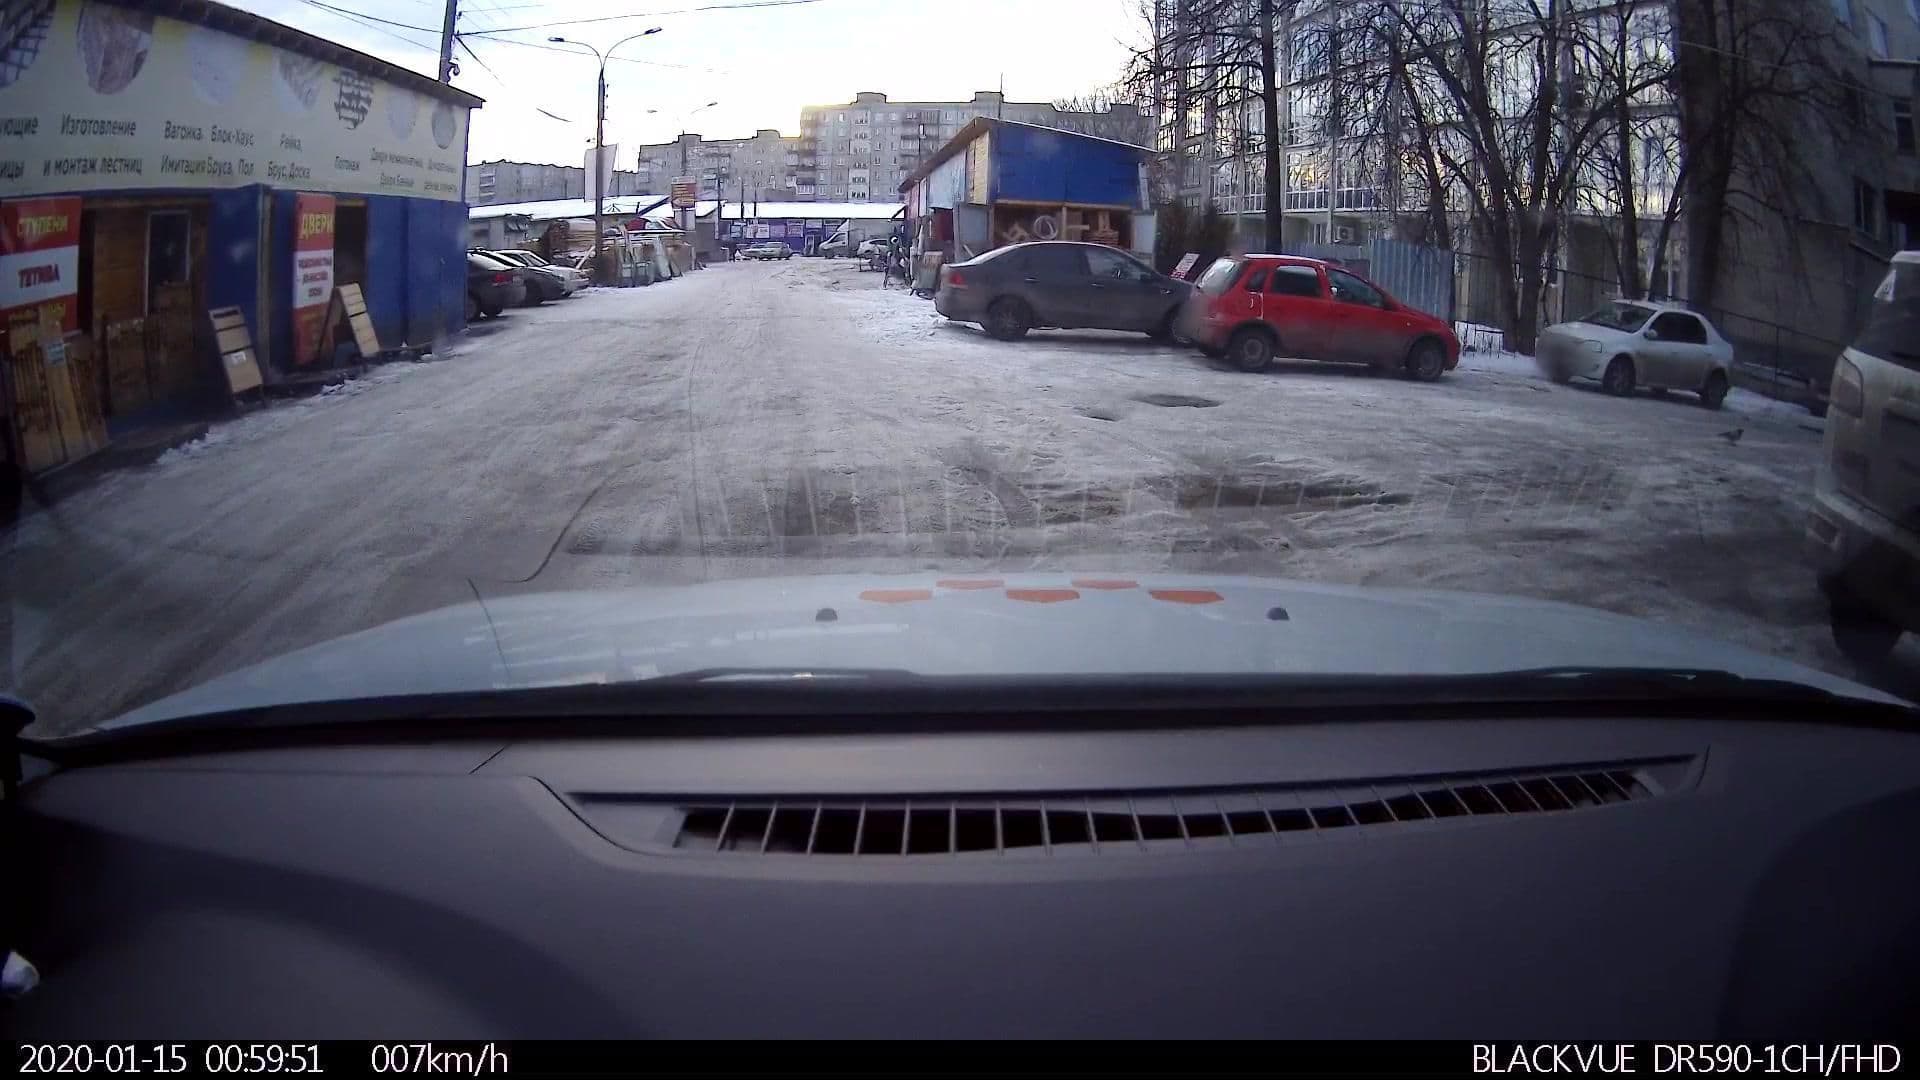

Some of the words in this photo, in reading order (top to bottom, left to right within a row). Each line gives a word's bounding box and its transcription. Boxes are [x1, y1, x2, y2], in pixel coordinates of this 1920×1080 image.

[0, 116, 39, 139] ющие
[60, 112, 136, 136] Изготовление
[43, 159, 52, 177] и
[54, 157, 98, 177] монтаж
[101, 157, 143, 177] лестниц
[160, 154, 206, 175] Имитация
[17, 215, 69, 237] СТУПЕНИ
[300, 212, 334, 240] ДВЕРИ
